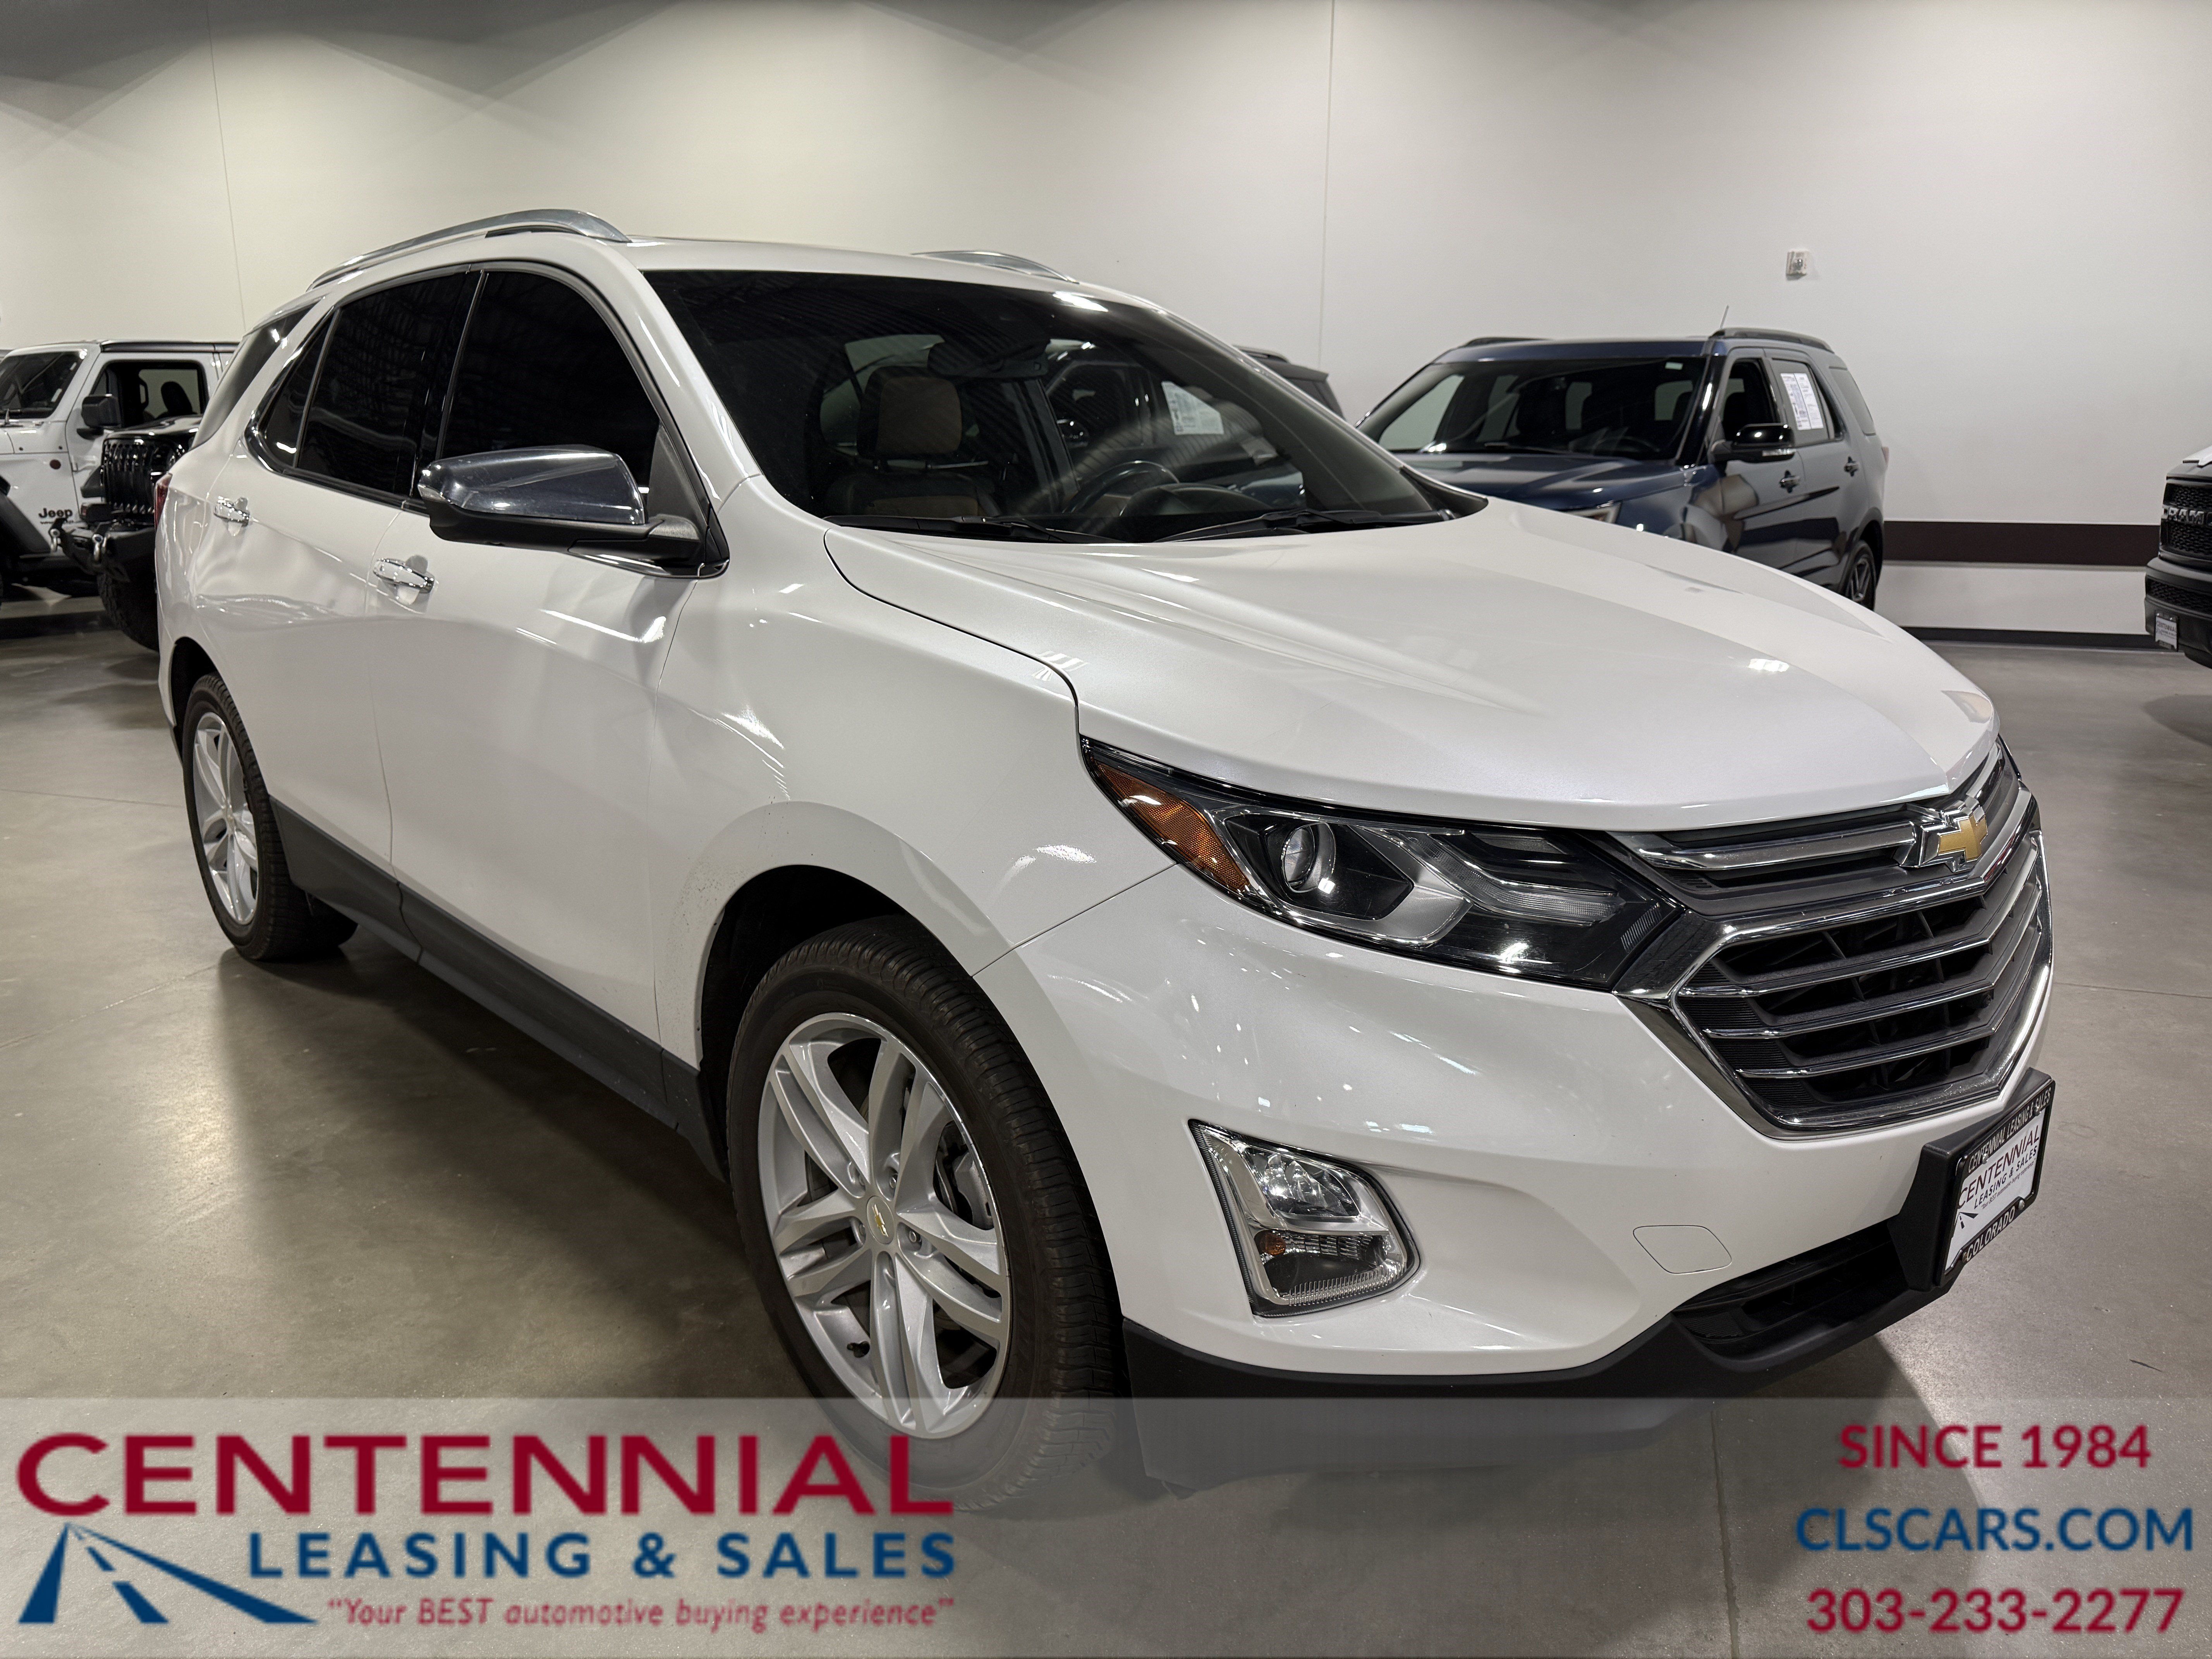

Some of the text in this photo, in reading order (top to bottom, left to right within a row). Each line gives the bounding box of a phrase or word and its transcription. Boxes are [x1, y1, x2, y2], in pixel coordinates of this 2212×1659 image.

[38, 508, 73, 519] Jeep
[2169, 507, 2205, 524] RAM
[1968, 1127, 2005, 1173] CENTENNIAL
[2007, 1106, 2030, 1139] LEASING
[2029, 1102, 2034, 1118] &
[2035, 1087, 2052, 1109] SALES
[1958, 1125, 2039, 1209] CENTENNIAL
[1974, 1173, 2007, 1209] LEASING
[2009, 1166, 2014, 1178] &
[2016, 1145, 2037, 1171] SALES
[1966, 1206, 2015, 1262] COLORADO
